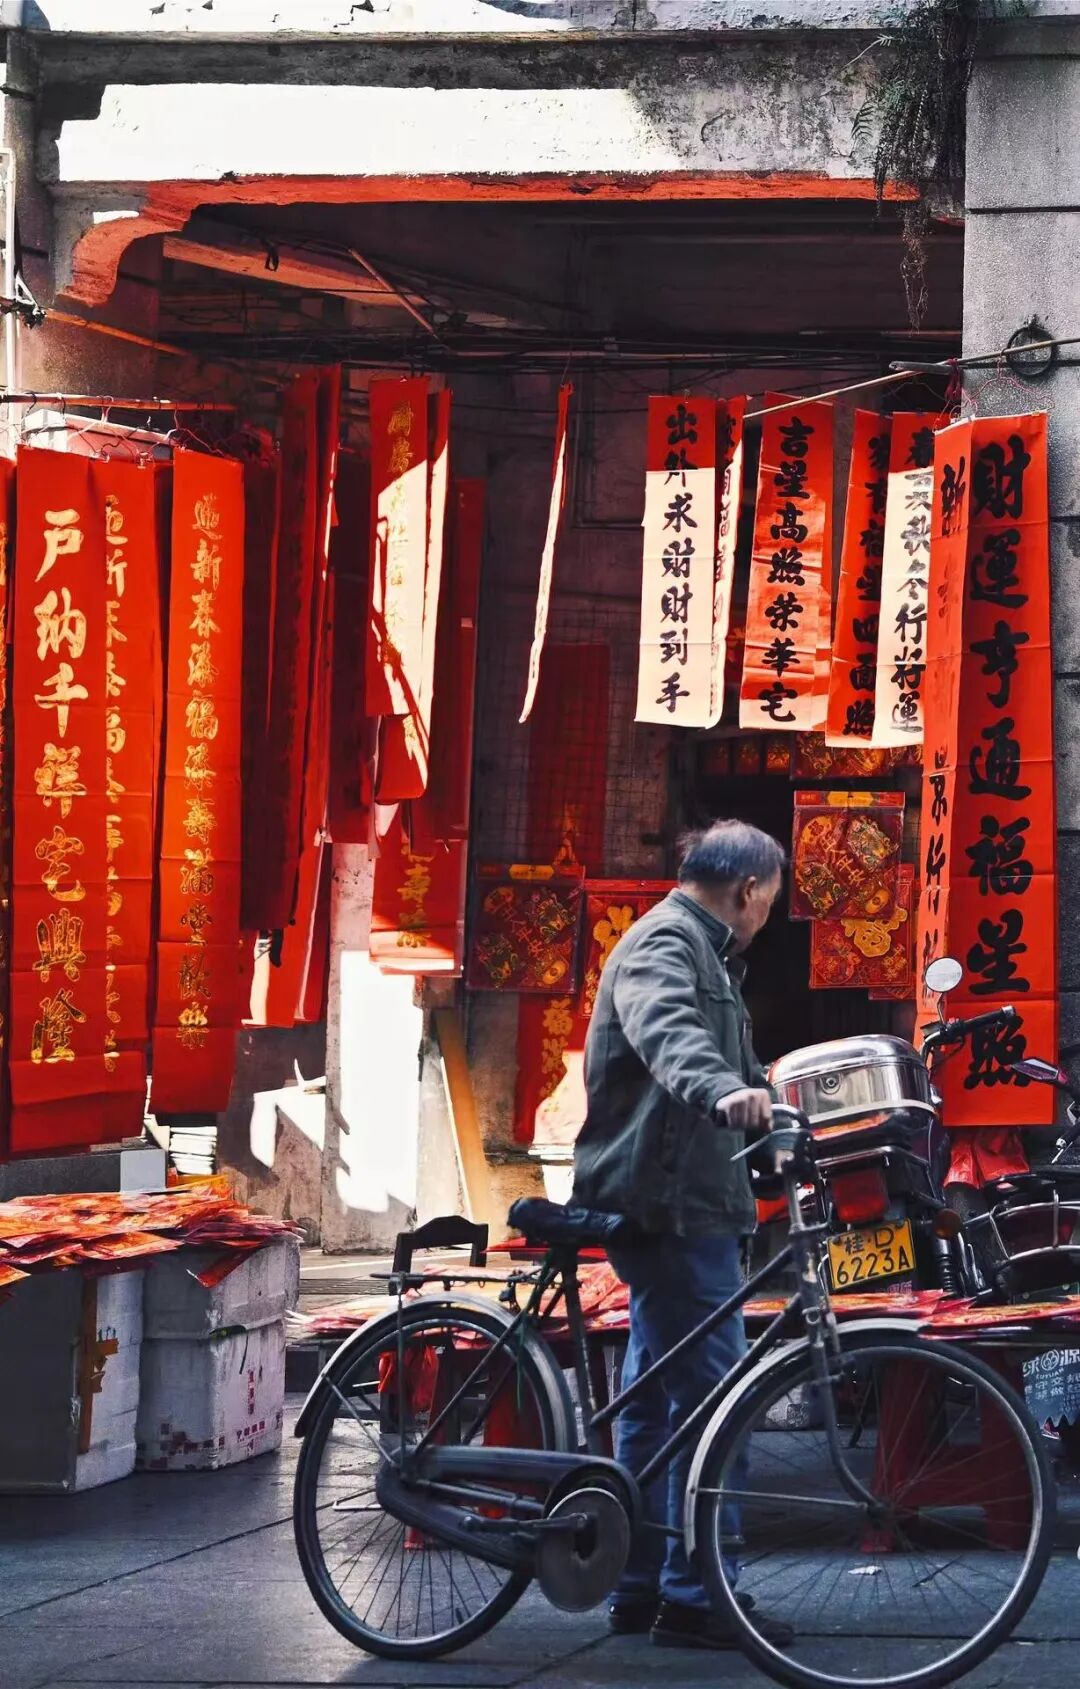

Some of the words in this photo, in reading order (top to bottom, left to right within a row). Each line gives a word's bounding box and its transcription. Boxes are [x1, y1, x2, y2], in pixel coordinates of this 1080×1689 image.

[655, 403, 698, 714] 出外求財財到手
[963, 433, 1032, 1090] 財運亨通福星照
[836, 1245, 910, 1285] 6223A
